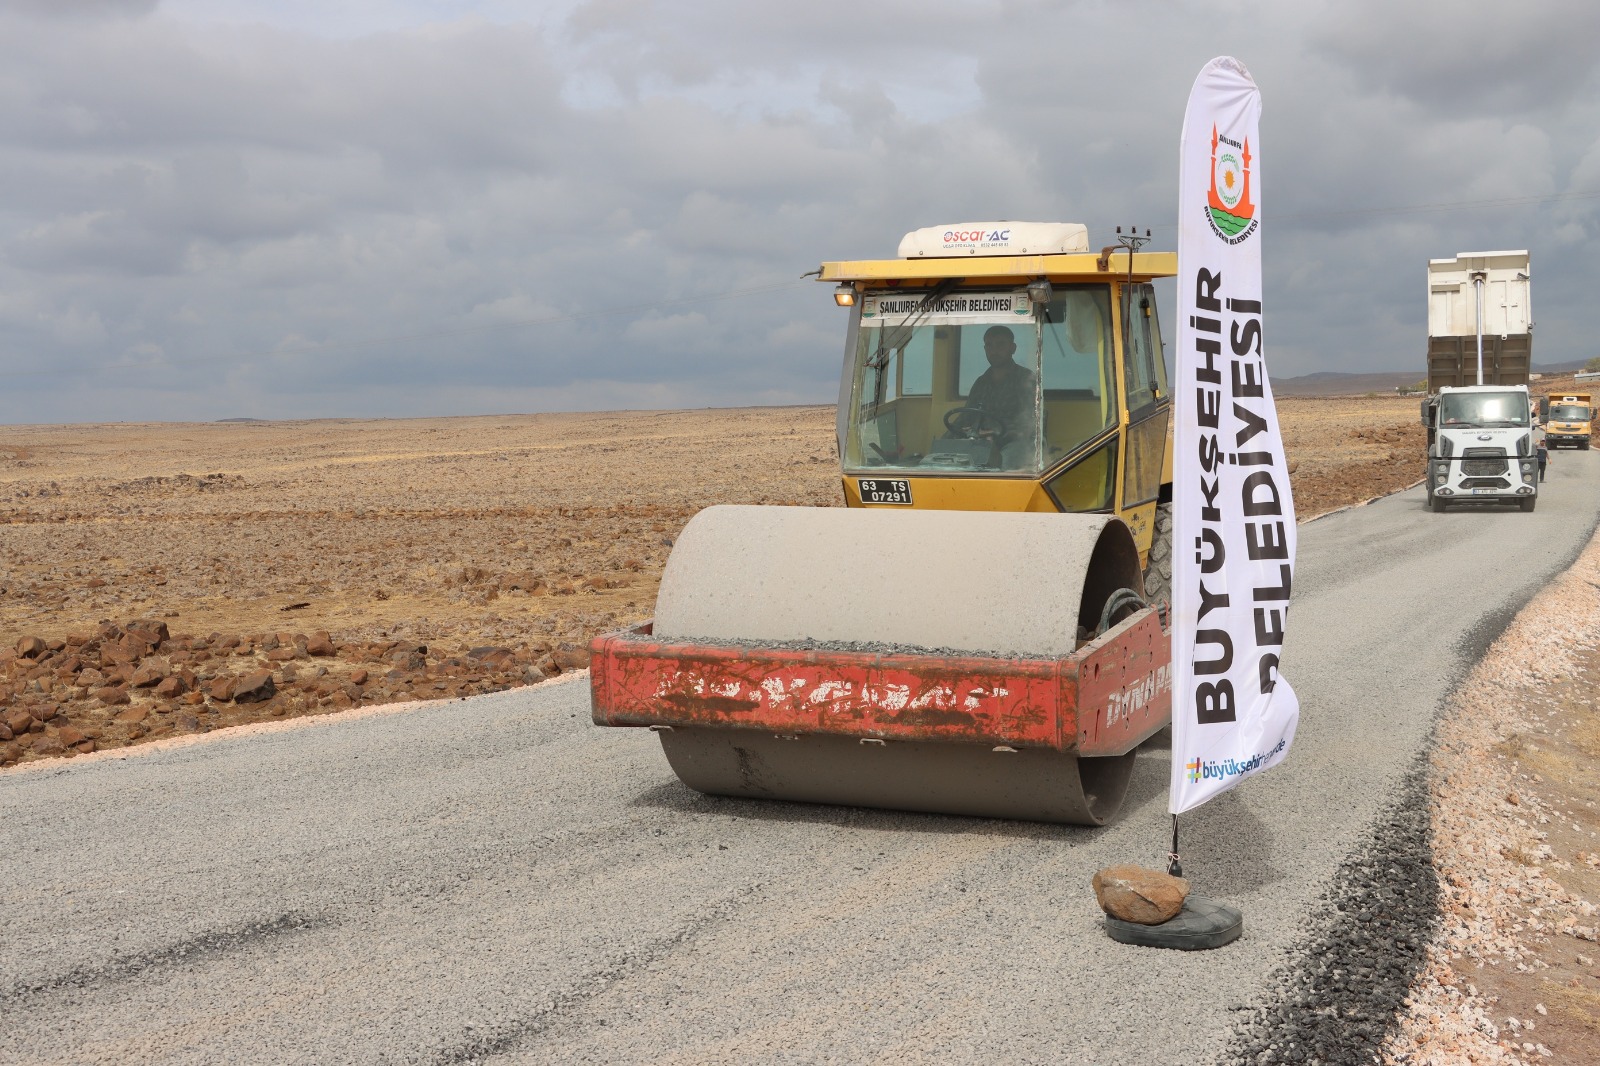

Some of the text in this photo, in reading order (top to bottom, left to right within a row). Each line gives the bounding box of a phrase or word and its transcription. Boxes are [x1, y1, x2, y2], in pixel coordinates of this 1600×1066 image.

[880, 300, 920, 317] ŞANLIURFA
[969, 296, 1012, 311] BELEDİYESİ
[862, 481, 906, 492] 63 TS
[871, 491, 907, 502] 07291
[1190, 266, 1237, 725] BÜYÜKŞEHİR
